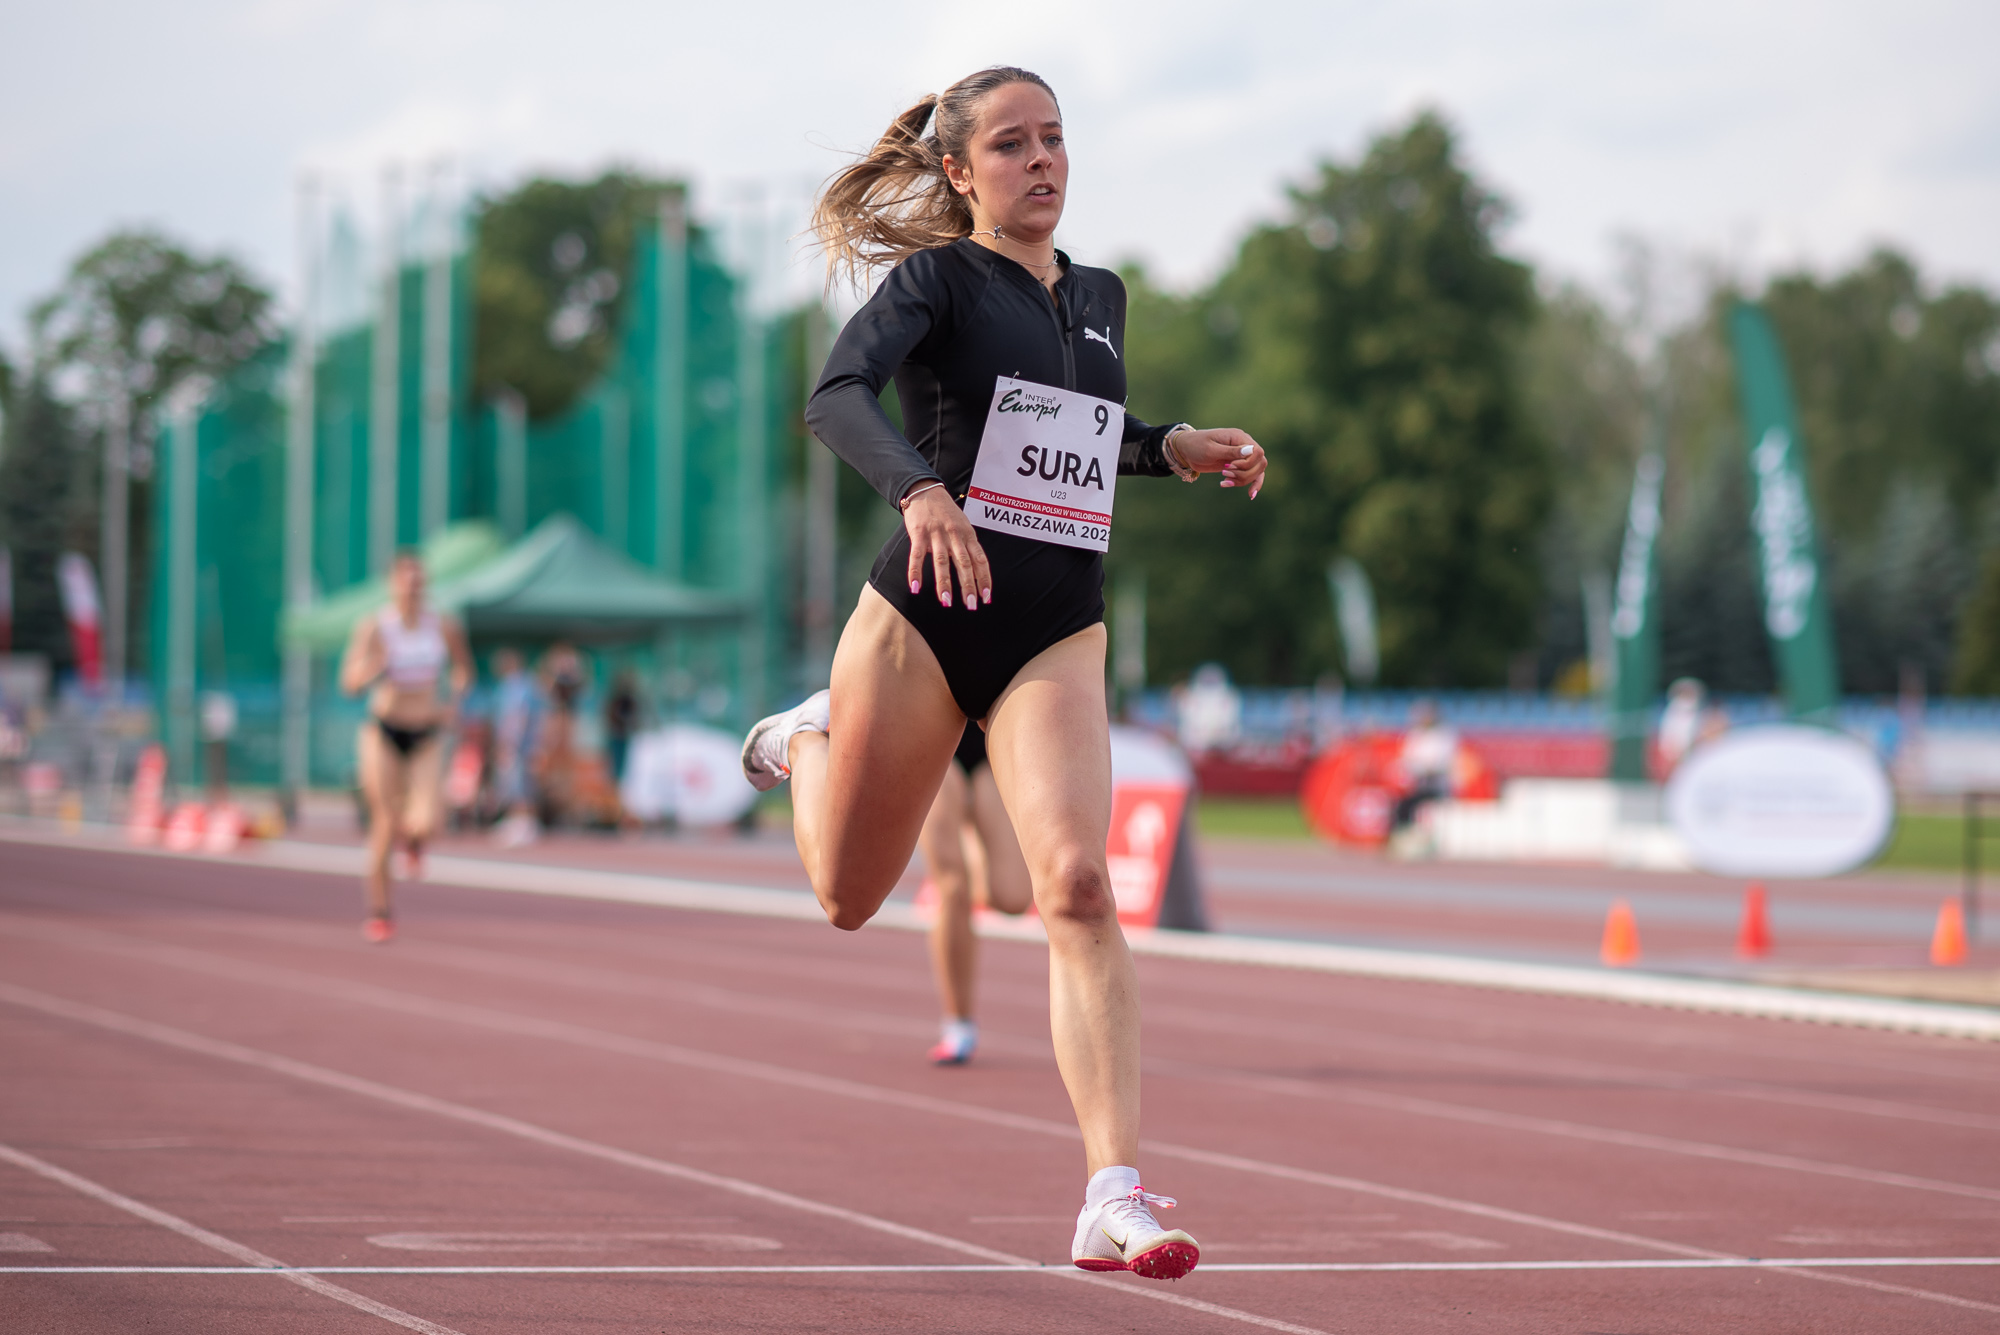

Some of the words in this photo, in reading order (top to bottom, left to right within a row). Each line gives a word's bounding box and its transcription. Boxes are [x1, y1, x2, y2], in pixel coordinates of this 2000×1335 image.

[997, 388, 1062, 422] Europol
[1094, 404, 1109, 436] 9
[1016, 444, 1104, 491] SURA
[979, 491, 996, 502] PZLA
[996, 495, 1042, 511] MISTRZOSTWA
[1041, 505, 1063, 516] POLSKI
[1062, 509, 1070, 517] W
[1050, 489, 1067, 500] U23
[984, 505, 1076, 537] WARSZAWA
